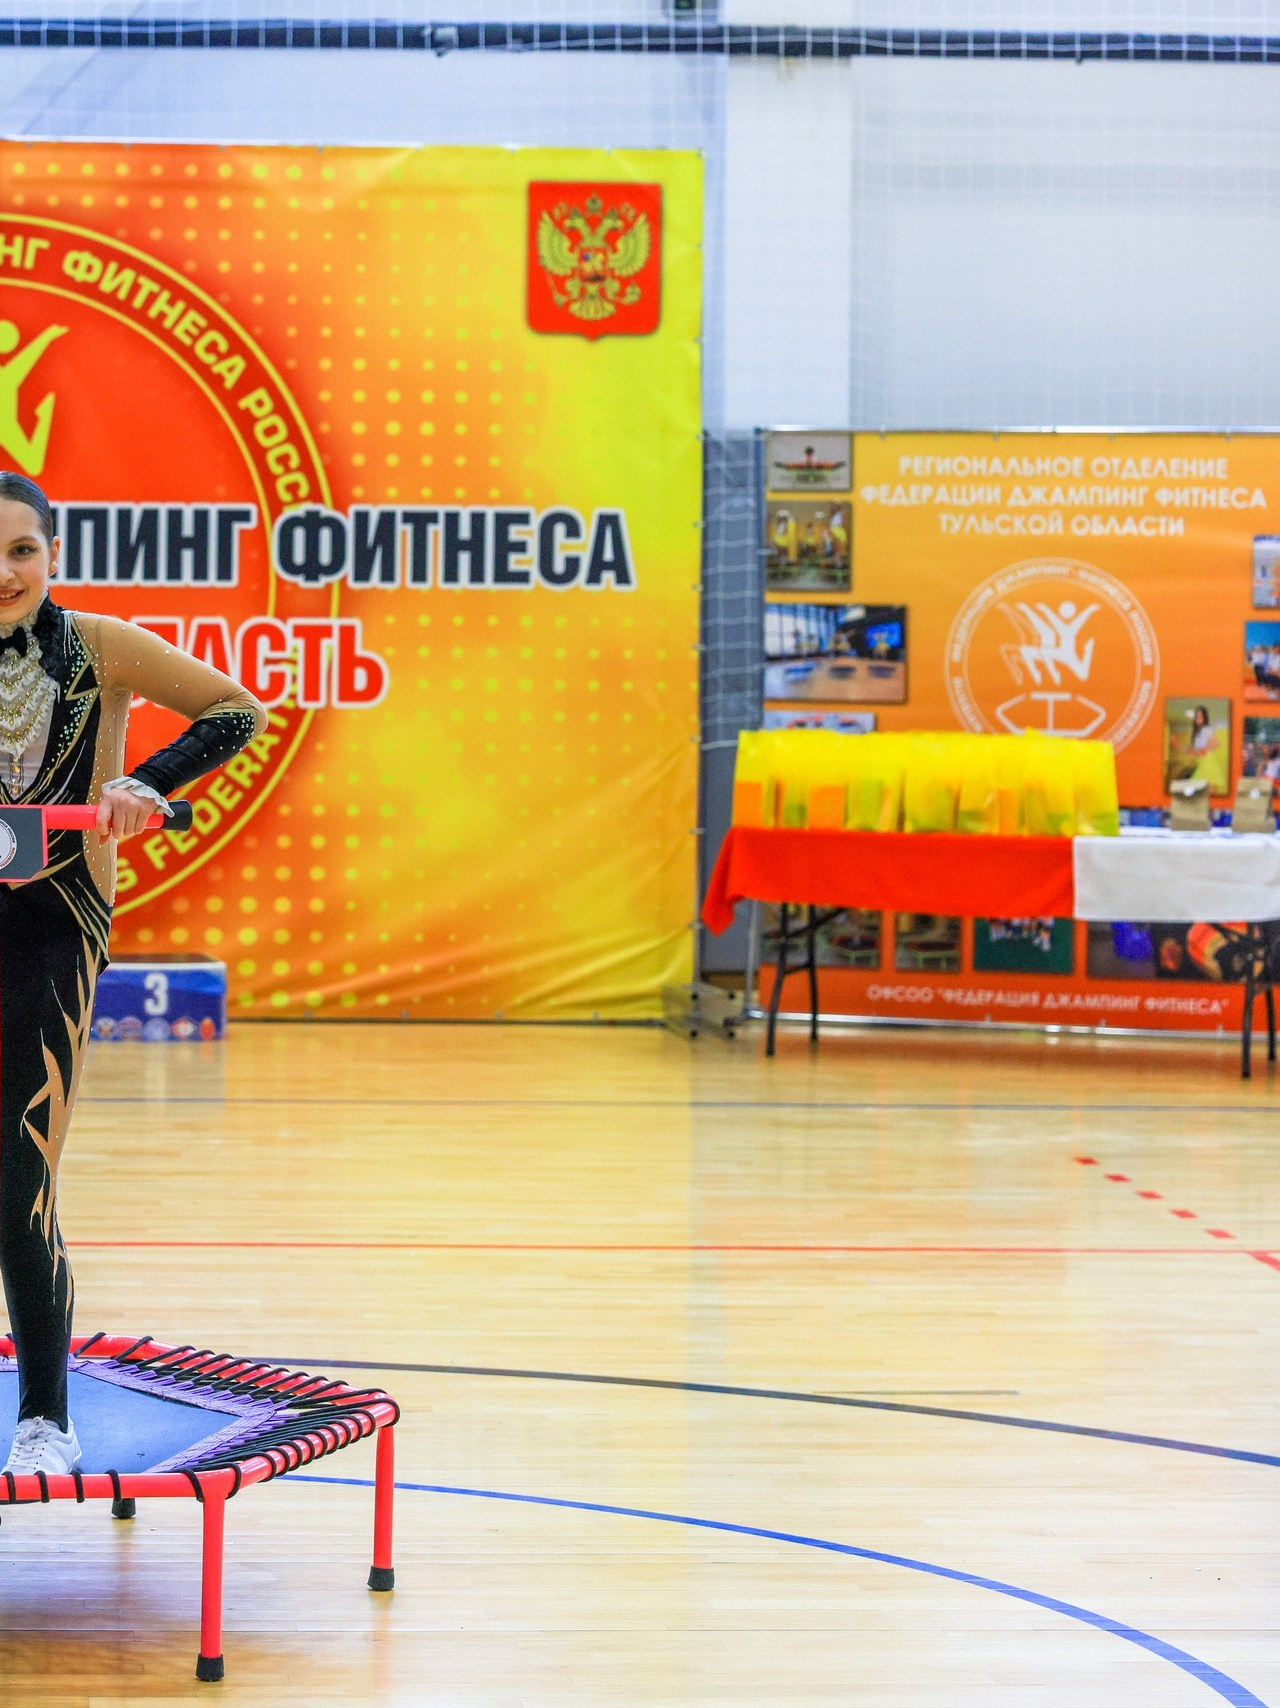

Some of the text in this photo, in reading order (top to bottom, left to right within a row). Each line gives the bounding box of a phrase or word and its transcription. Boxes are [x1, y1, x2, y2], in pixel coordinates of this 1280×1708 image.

[61, 249, 245, 390] ФИТНЕСА
[237, 386, 312, 512] РОСС
[898, 456, 1228, 482] РЕГИОНАЛЬНОЕ ОТДЕЛЕНИЕ
[859, 483, 1268, 509] ФЕДЕРАЦИИ ДЖАМПИНГ ФИТНЕСА
[937, 511, 1185, 537] ТУЛЬСКОЙ ОБЛАСТИ
[275, 506, 636, 590] ФИТНЕСА
[144, 972, 169, 1016] 3
